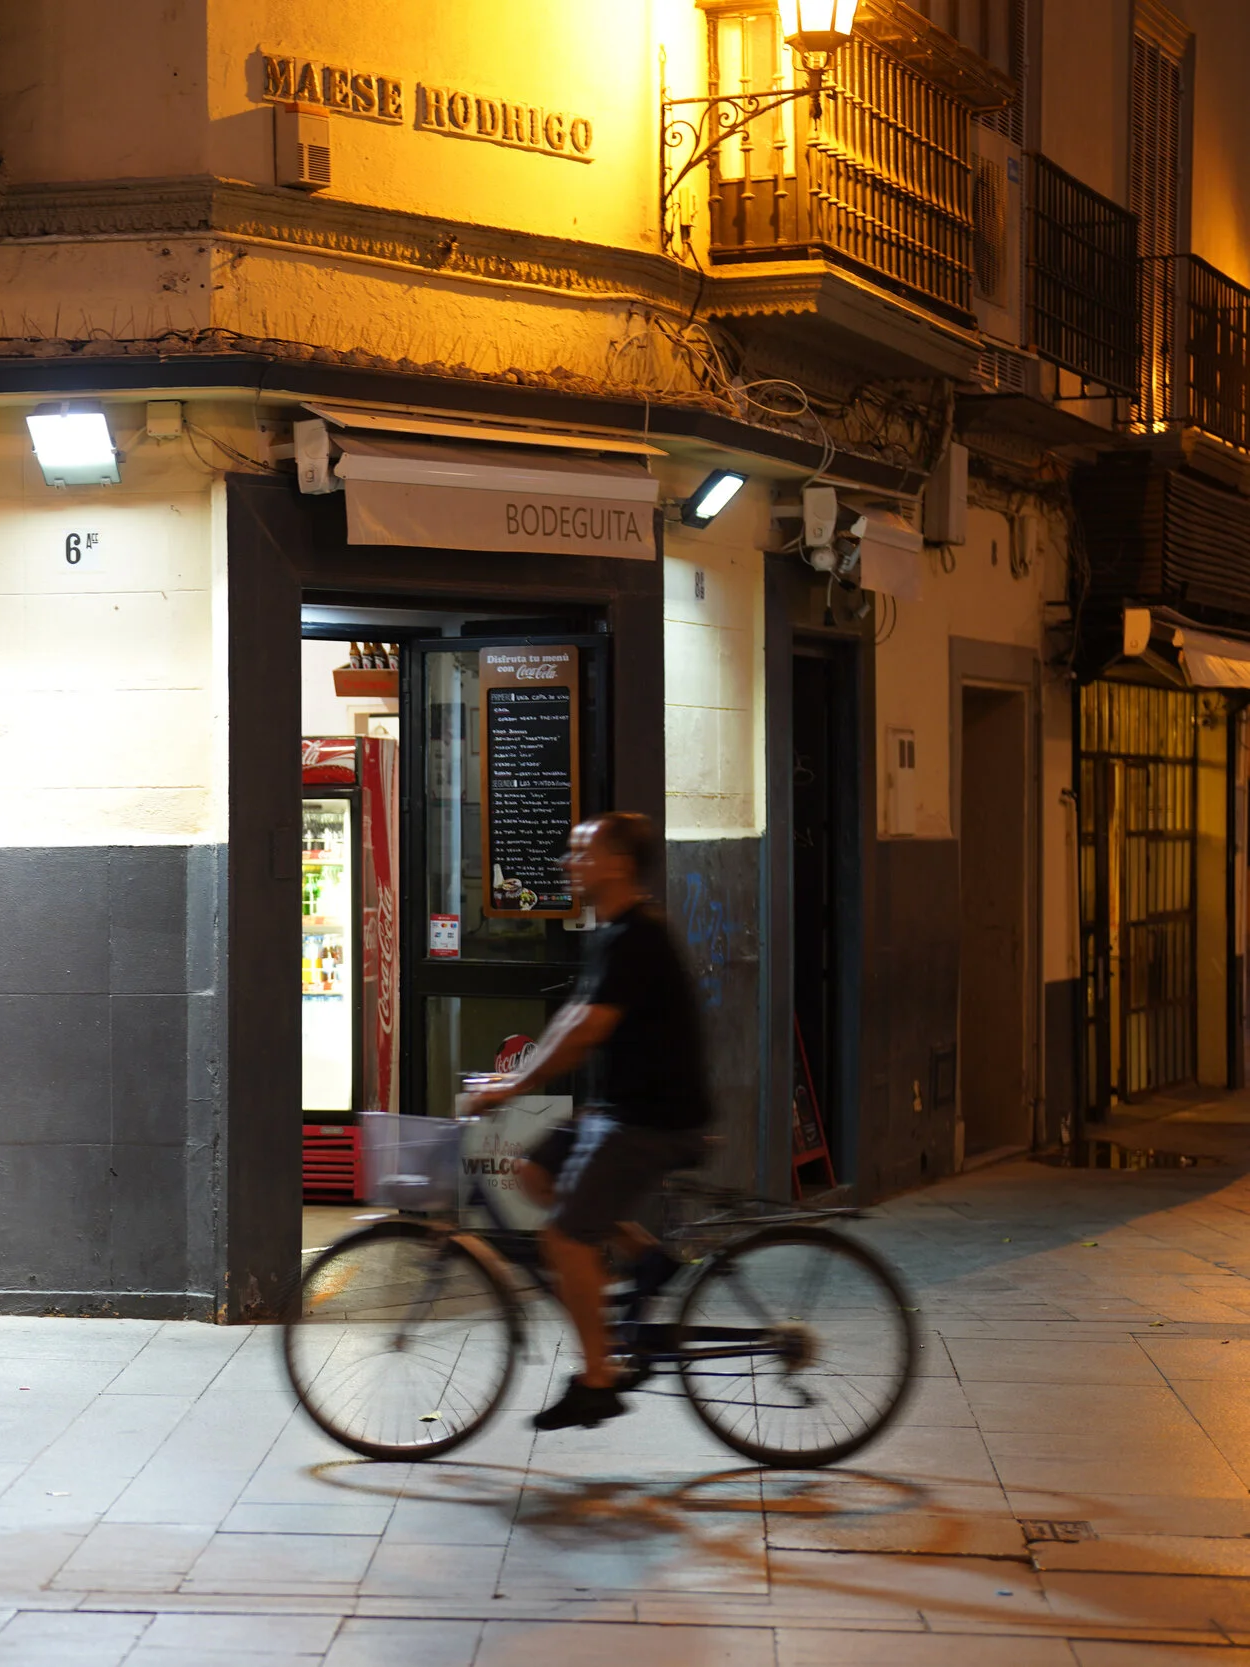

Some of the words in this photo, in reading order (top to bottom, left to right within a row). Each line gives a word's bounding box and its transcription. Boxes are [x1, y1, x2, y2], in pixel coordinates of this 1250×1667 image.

[263, 55, 404, 120] MAESE
[421, 82, 594, 155] RODRIGO
[506, 503, 642, 543] BODEGUITA
[65, 532, 81, 565] 6
[486, 654, 527, 663] Disfruta
